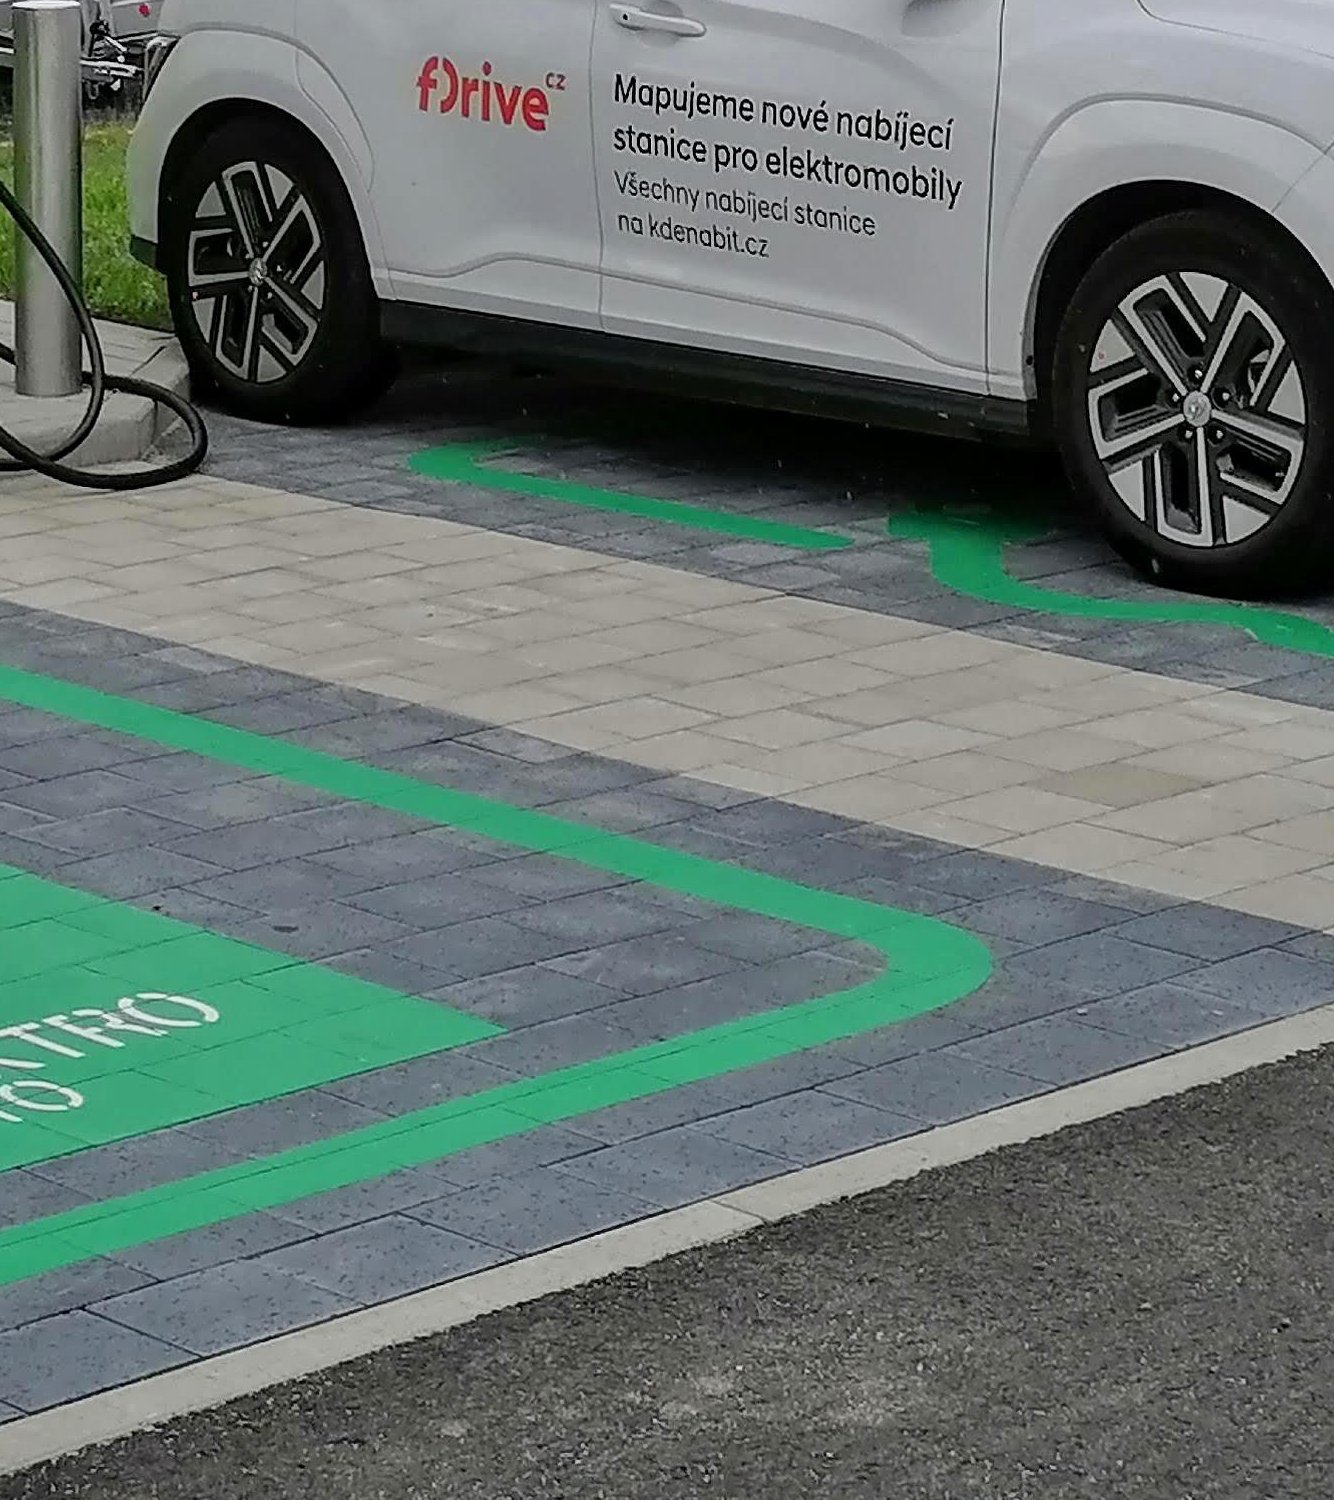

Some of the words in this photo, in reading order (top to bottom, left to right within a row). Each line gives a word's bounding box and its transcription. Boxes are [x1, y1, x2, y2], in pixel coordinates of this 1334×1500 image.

[615, 73, 754, 121] Mapujeme
[762, 100, 829, 132] nové
[836, 109, 954, 150] nabíjecí
[614, 128, 707, 163] stanice
[716, 143, 758, 172] pro
[766, 146, 962, 209] elektromobily
[615, 170, 700, 210] Všechny
[705, 190, 788, 223] nabíjecí
[794, 205, 876, 236] stanice
[618, 212, 643, 235] na
[649, 212, 770, 258] kdenabit.cz
